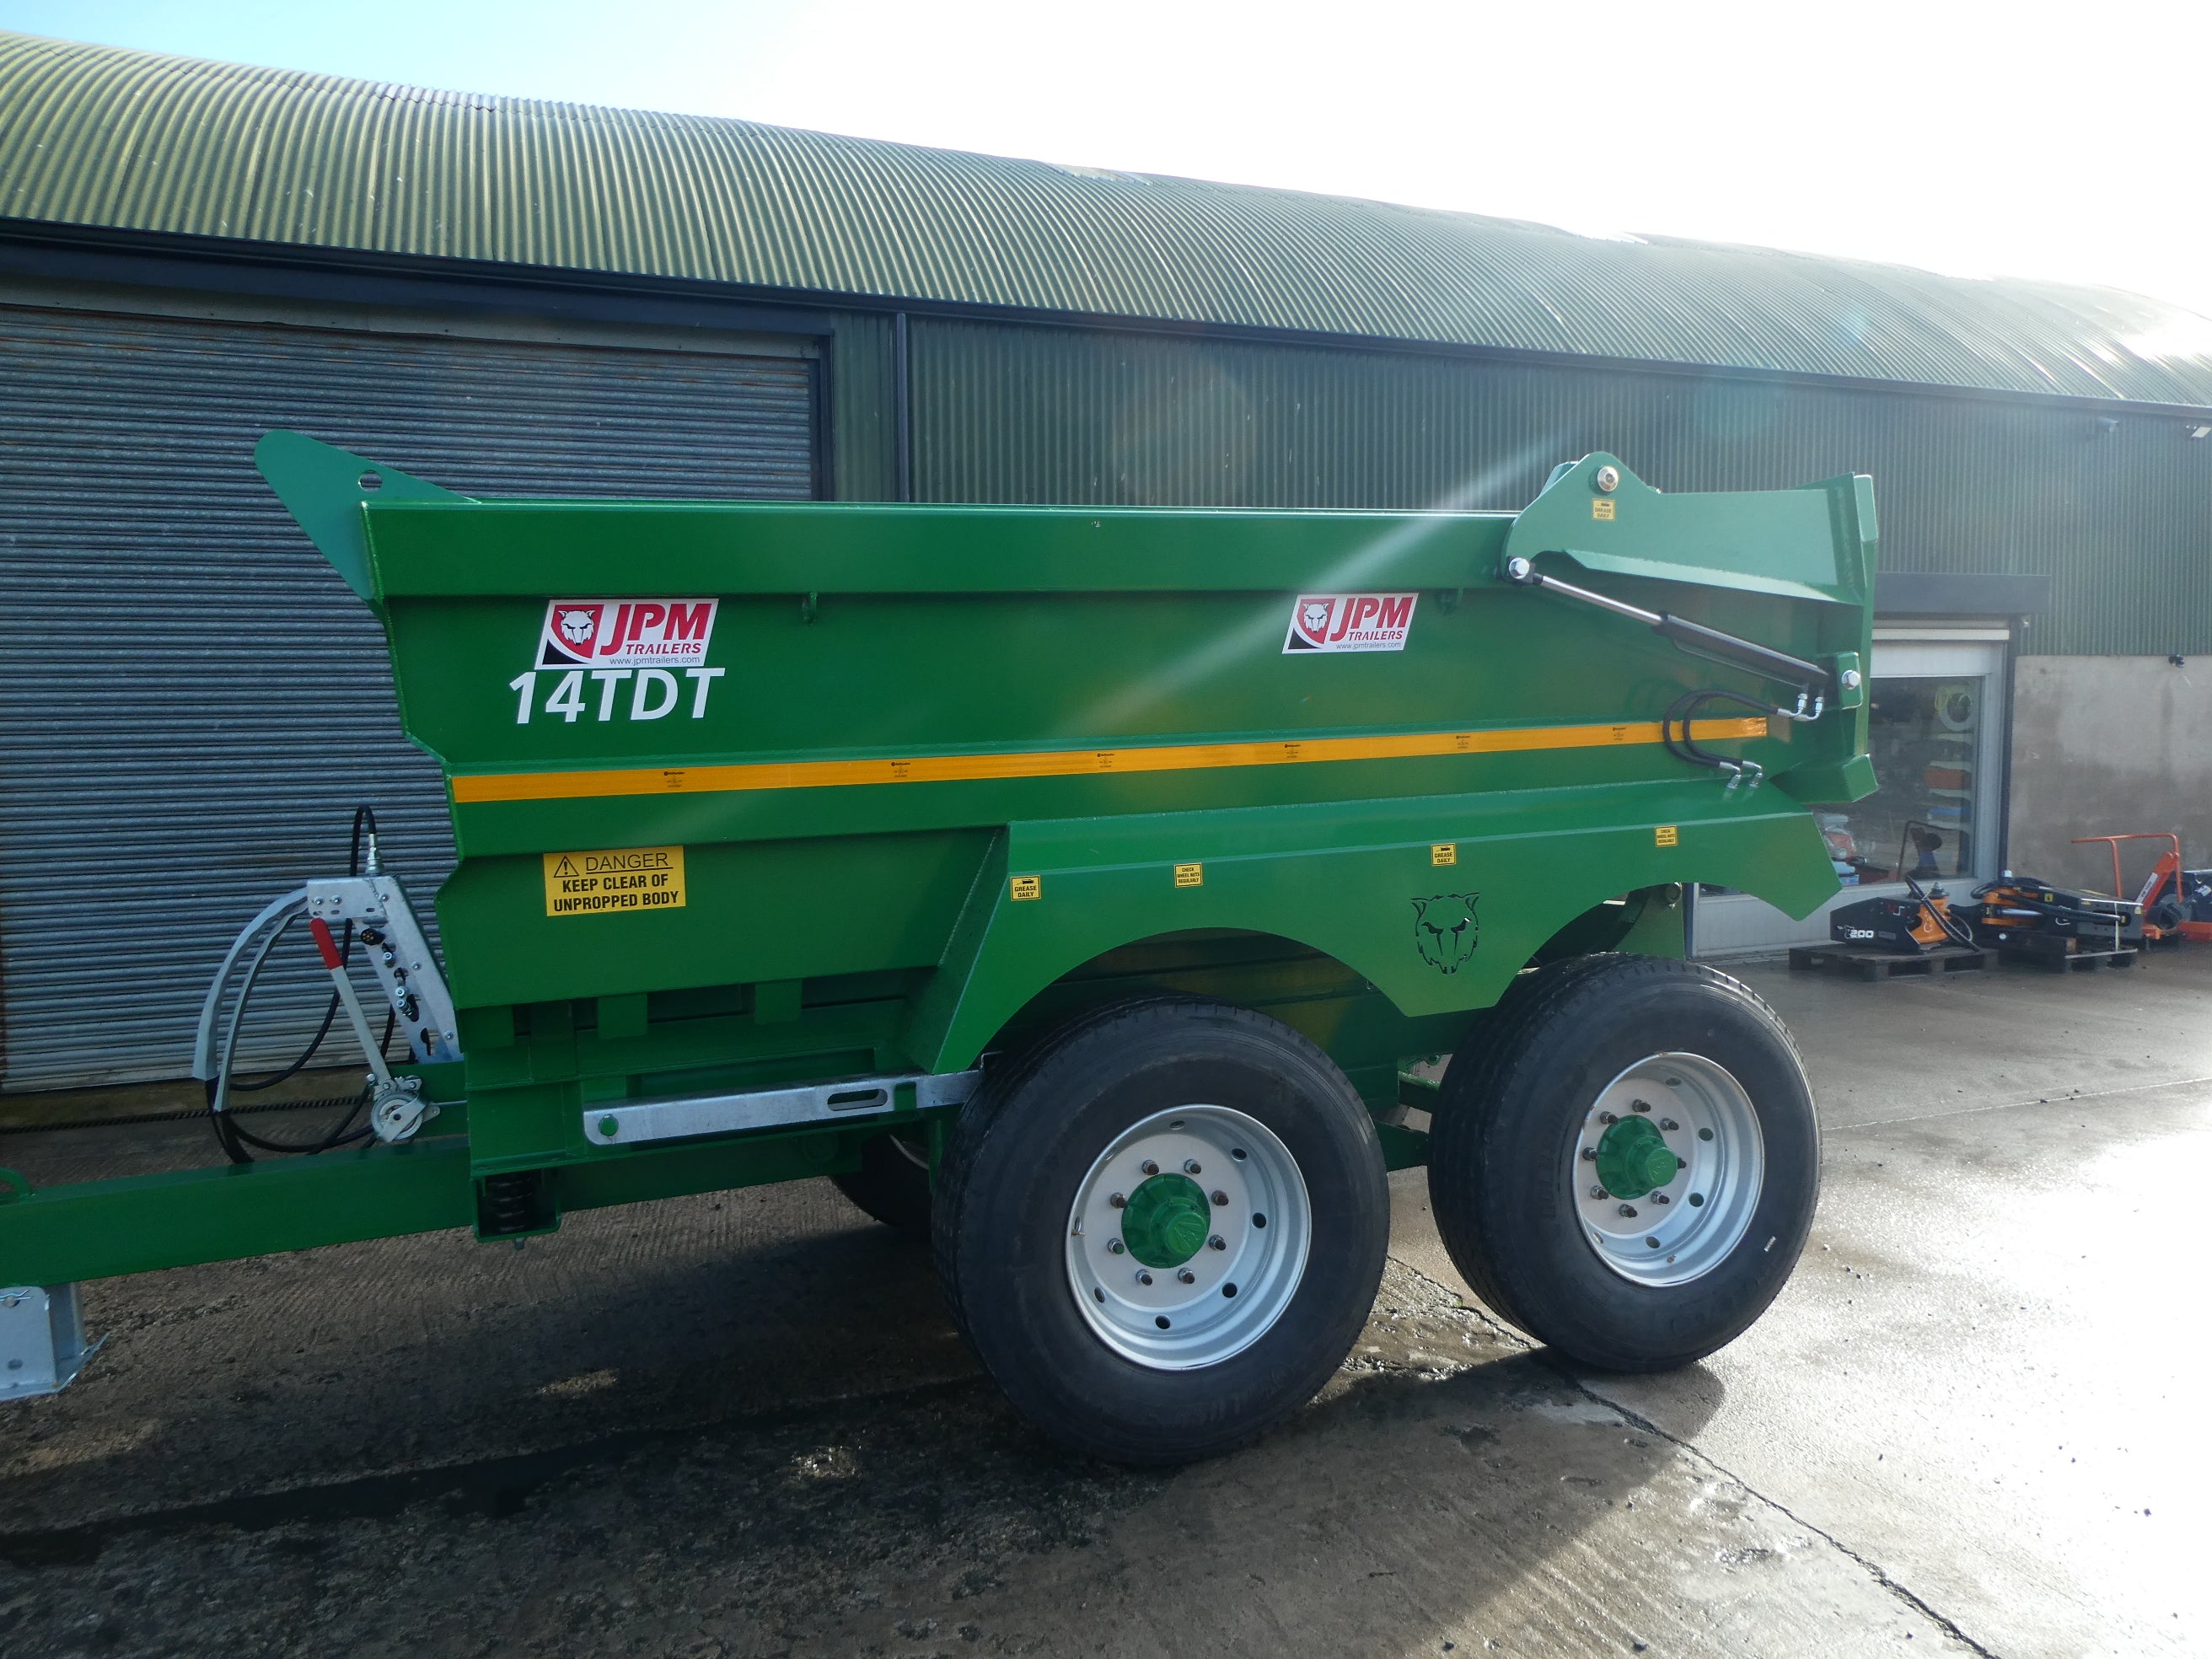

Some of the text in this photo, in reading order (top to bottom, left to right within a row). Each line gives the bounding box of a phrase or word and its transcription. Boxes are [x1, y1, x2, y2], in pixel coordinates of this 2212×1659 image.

[599, 603, 712, 656] JPM
[1329, 597, 1414, 642] JPM
[1335, 642, 1401, 650] www.jpmtrailers.com
[1349, 630, 1404, 642] TRAILERS
[625, 642, 701, 655] TRAILERS
[609, 656, 701, 666] www.jpmtrailers.com
[509, 668, 726, 724] 14TDT
[586, 852, 669, 872] DANGER
[562, 872, 668, 894] KEEP CLEAR OF
[554, 890, 679, 912] UNPROPPED BODY
